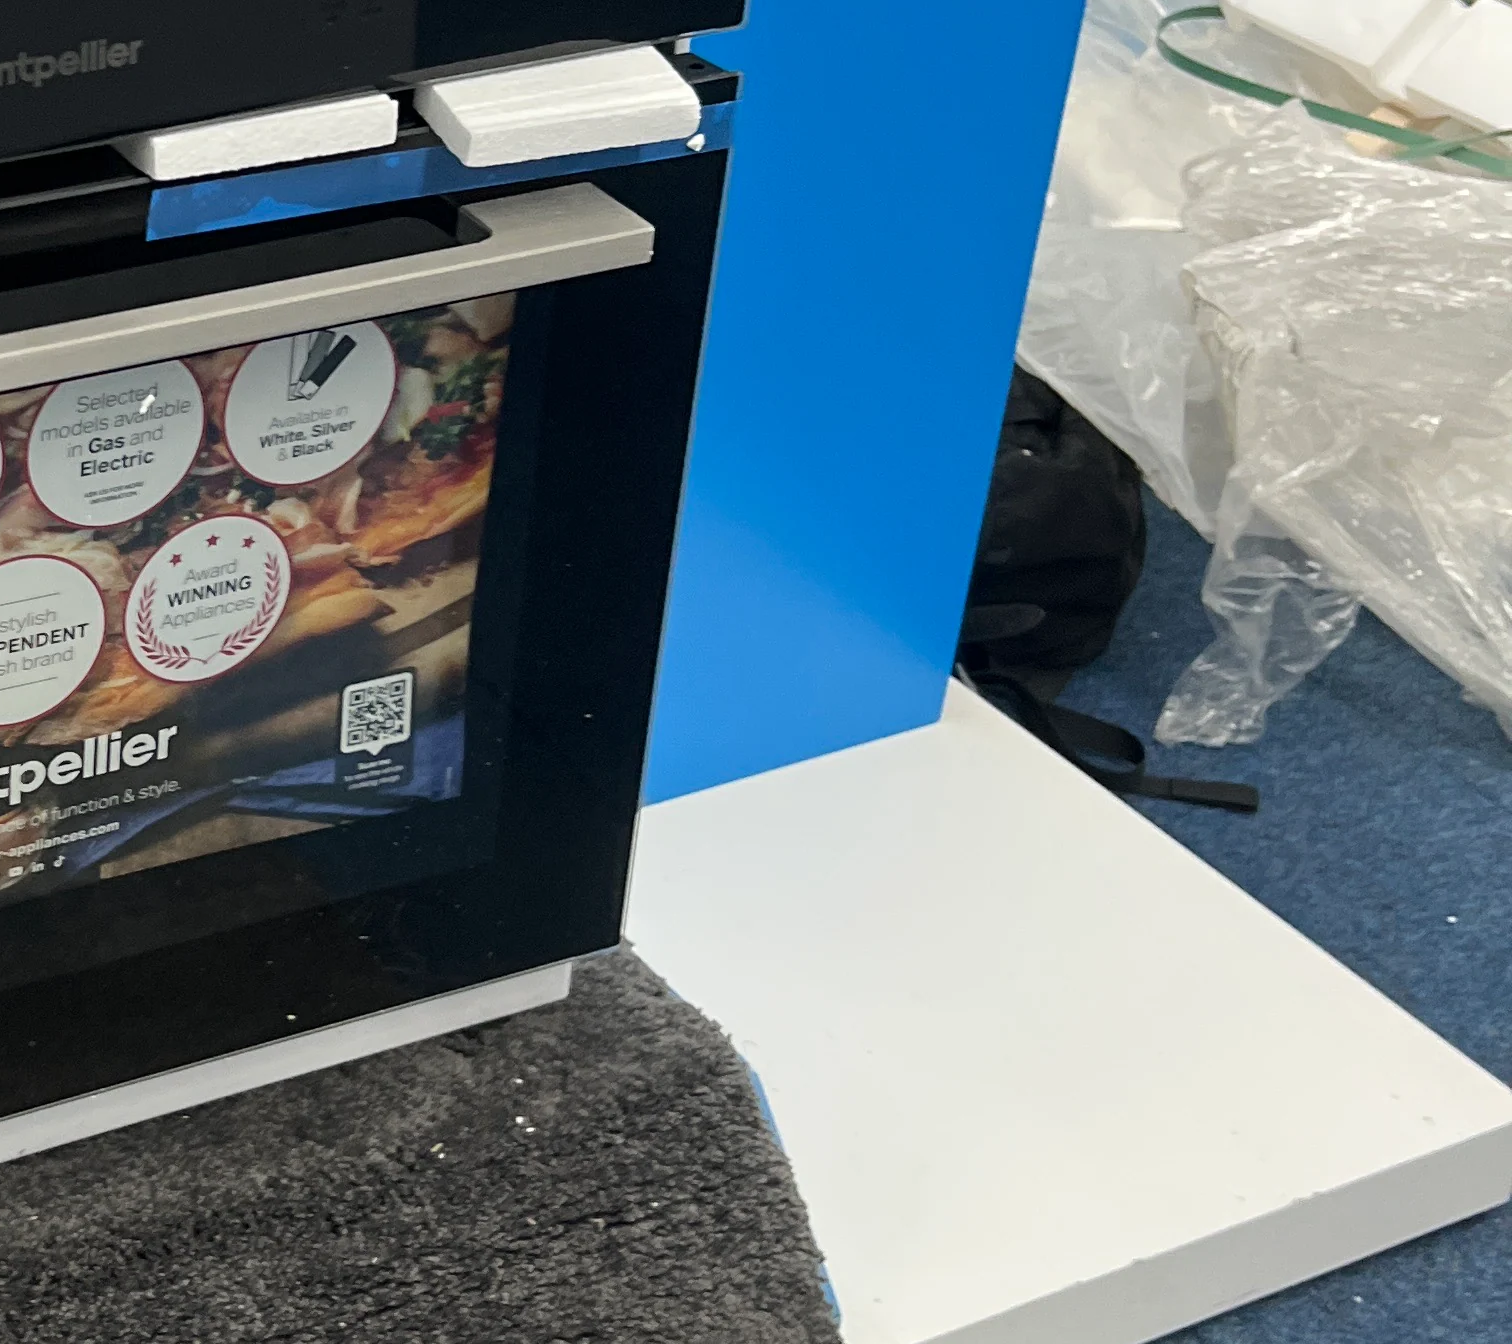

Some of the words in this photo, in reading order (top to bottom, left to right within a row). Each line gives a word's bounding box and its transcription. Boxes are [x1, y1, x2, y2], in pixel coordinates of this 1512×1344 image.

[76, 382, 159, 413] Selected
[40, 415, 109, 442] models
[113, 399, 192, 428] available
[268, 408, 333, 430] Available
[335, 406, 349, 417] in
[310, 420, 356, 438] Silver
[67, 442, 83, 458] in
[88, 435, 126, 454] Gas
[129, 424, 164, 446] and
[291, 439, 334, 458] Black
[79, 450, 156, 477] Electric
[183, 558, 238, 584] Award
[167, 575, 253, 608] WINNING
[159, 596, 257, 630] Appliances
[21, 646, 75, 671] brand
[29, 809, 49, 826] of
[50, 794, 120, 821] function
[122, 788, 136, 803] &
